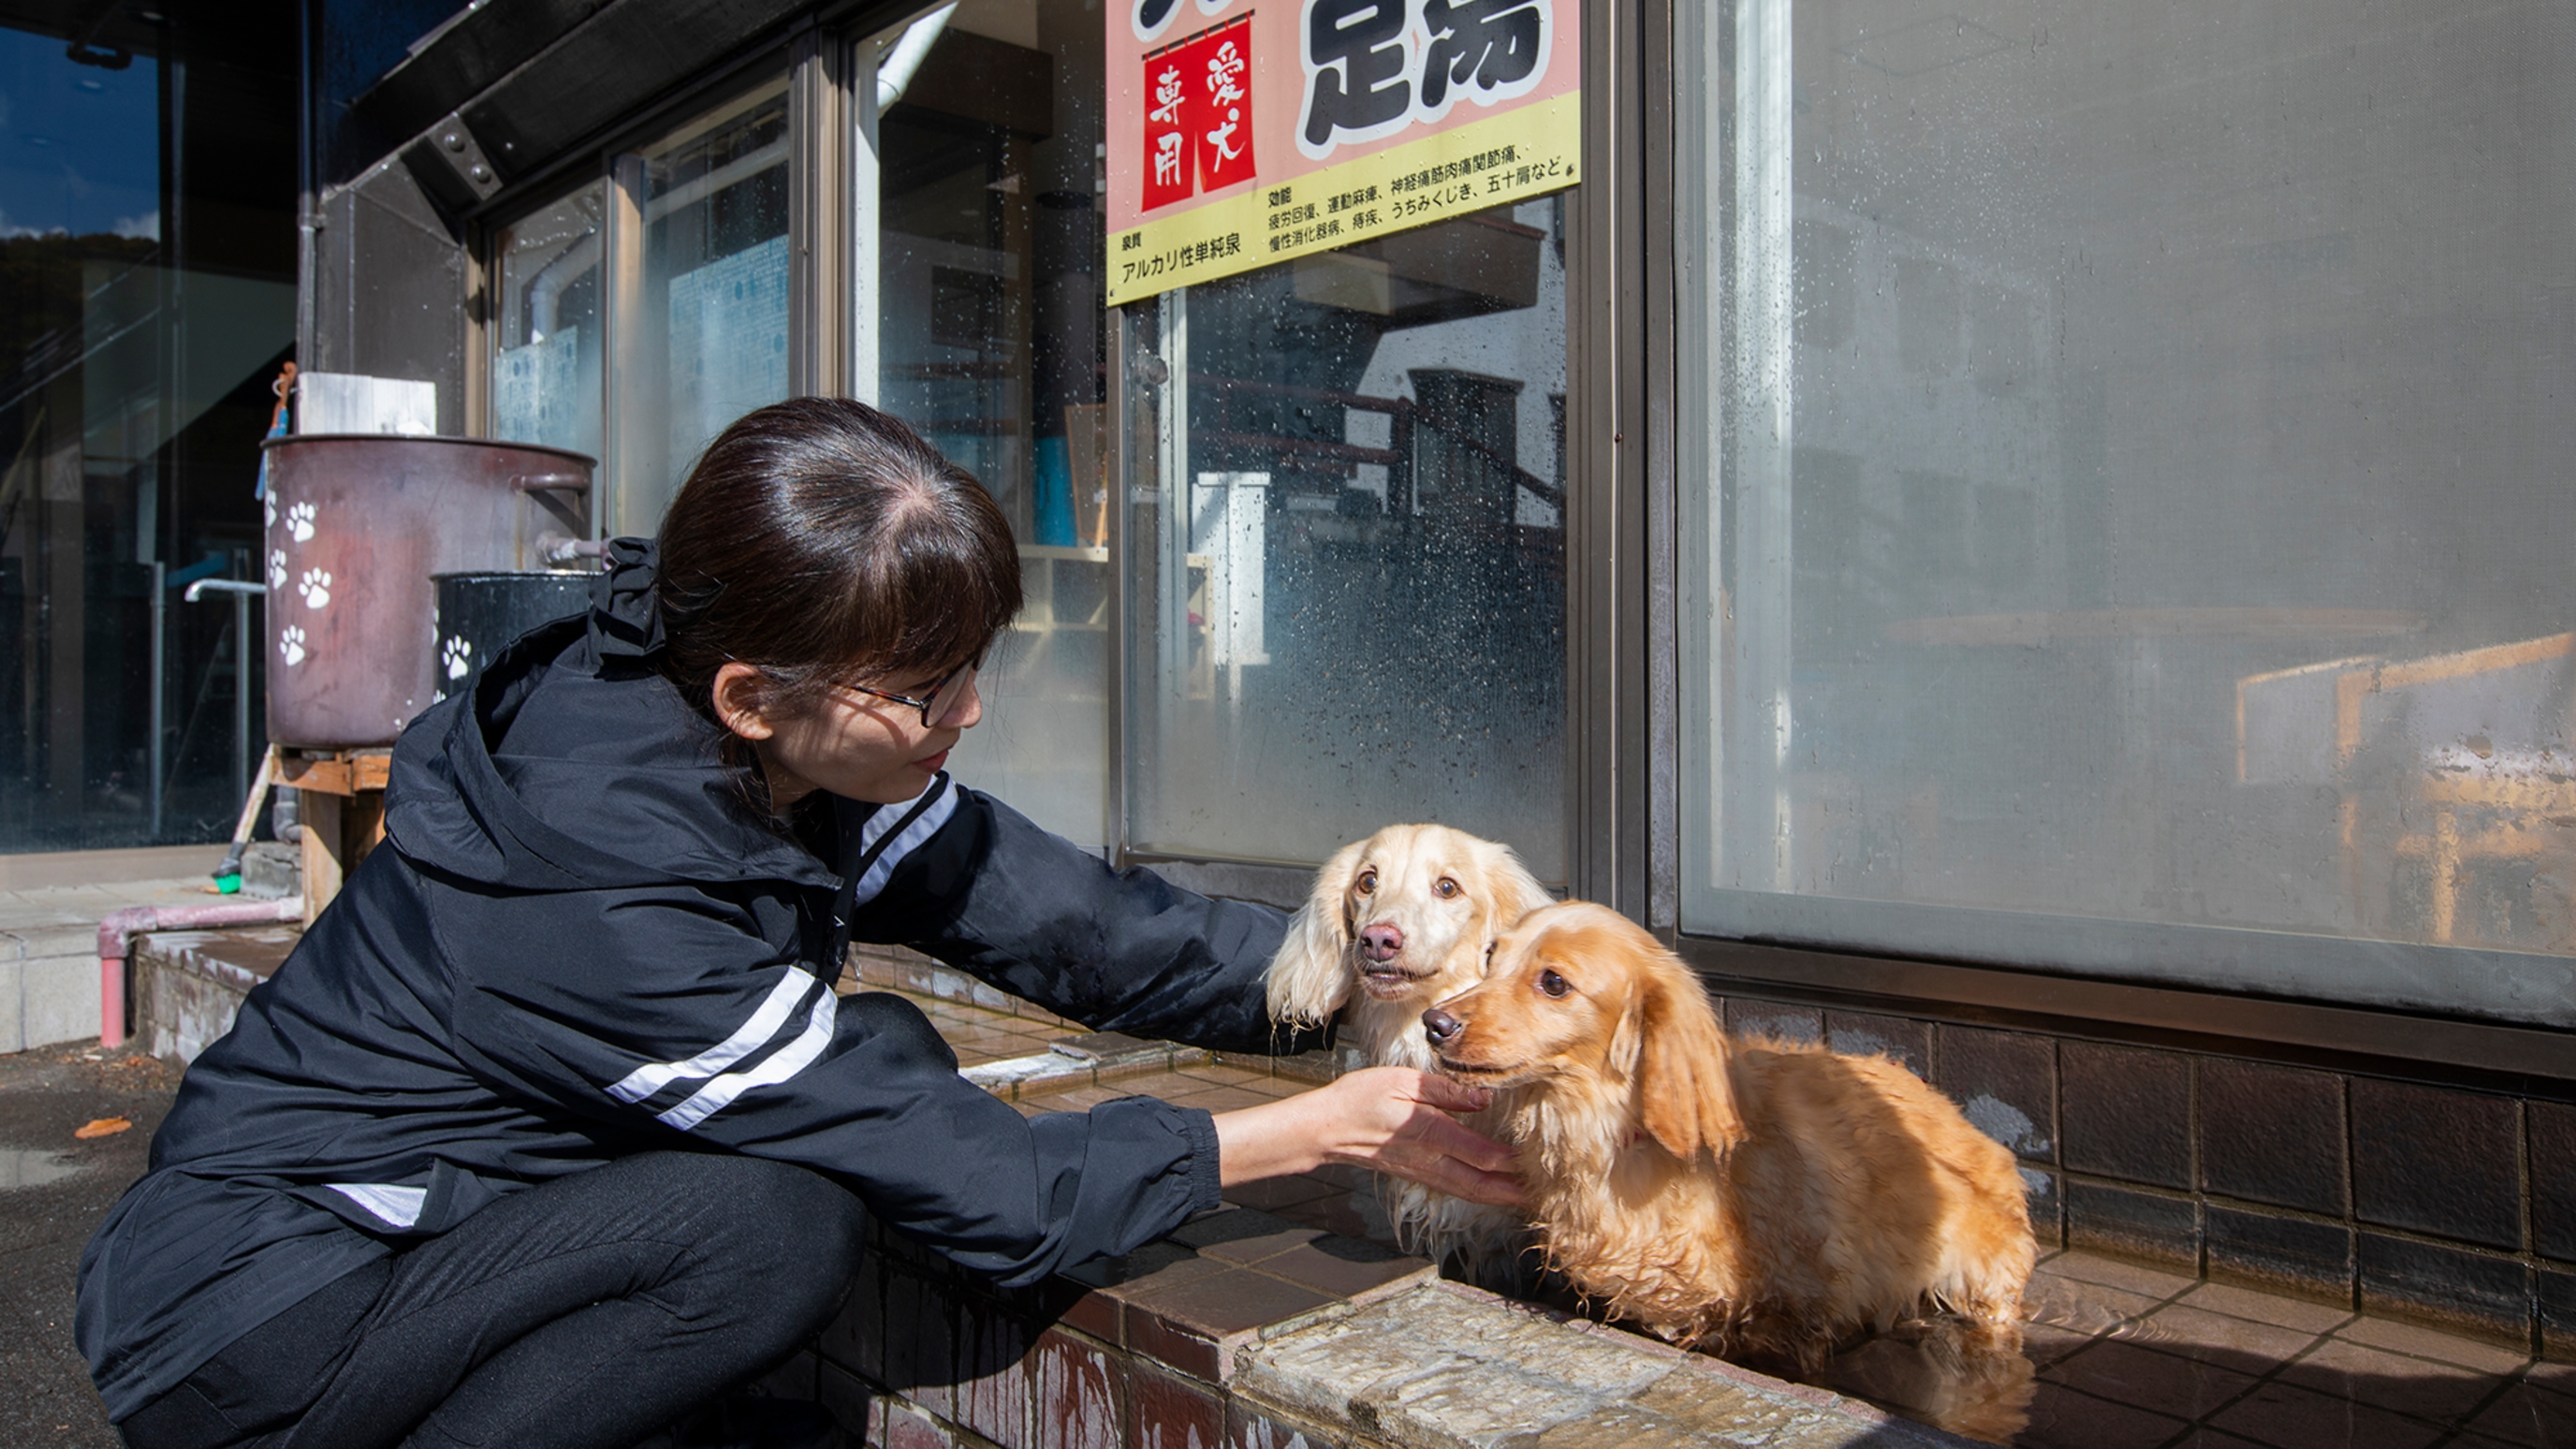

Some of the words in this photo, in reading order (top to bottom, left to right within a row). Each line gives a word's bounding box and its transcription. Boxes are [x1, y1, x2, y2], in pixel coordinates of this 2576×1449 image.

[1149, 65, 1186, 186] 専用
[1207, 40, 1246, 174] 愛犬
[1268, 186, 1292, 208] 効能
[1121, 231, 1141, 251] 泉質
[1122, 232, 1241, 284] アルカリ性単純泉
